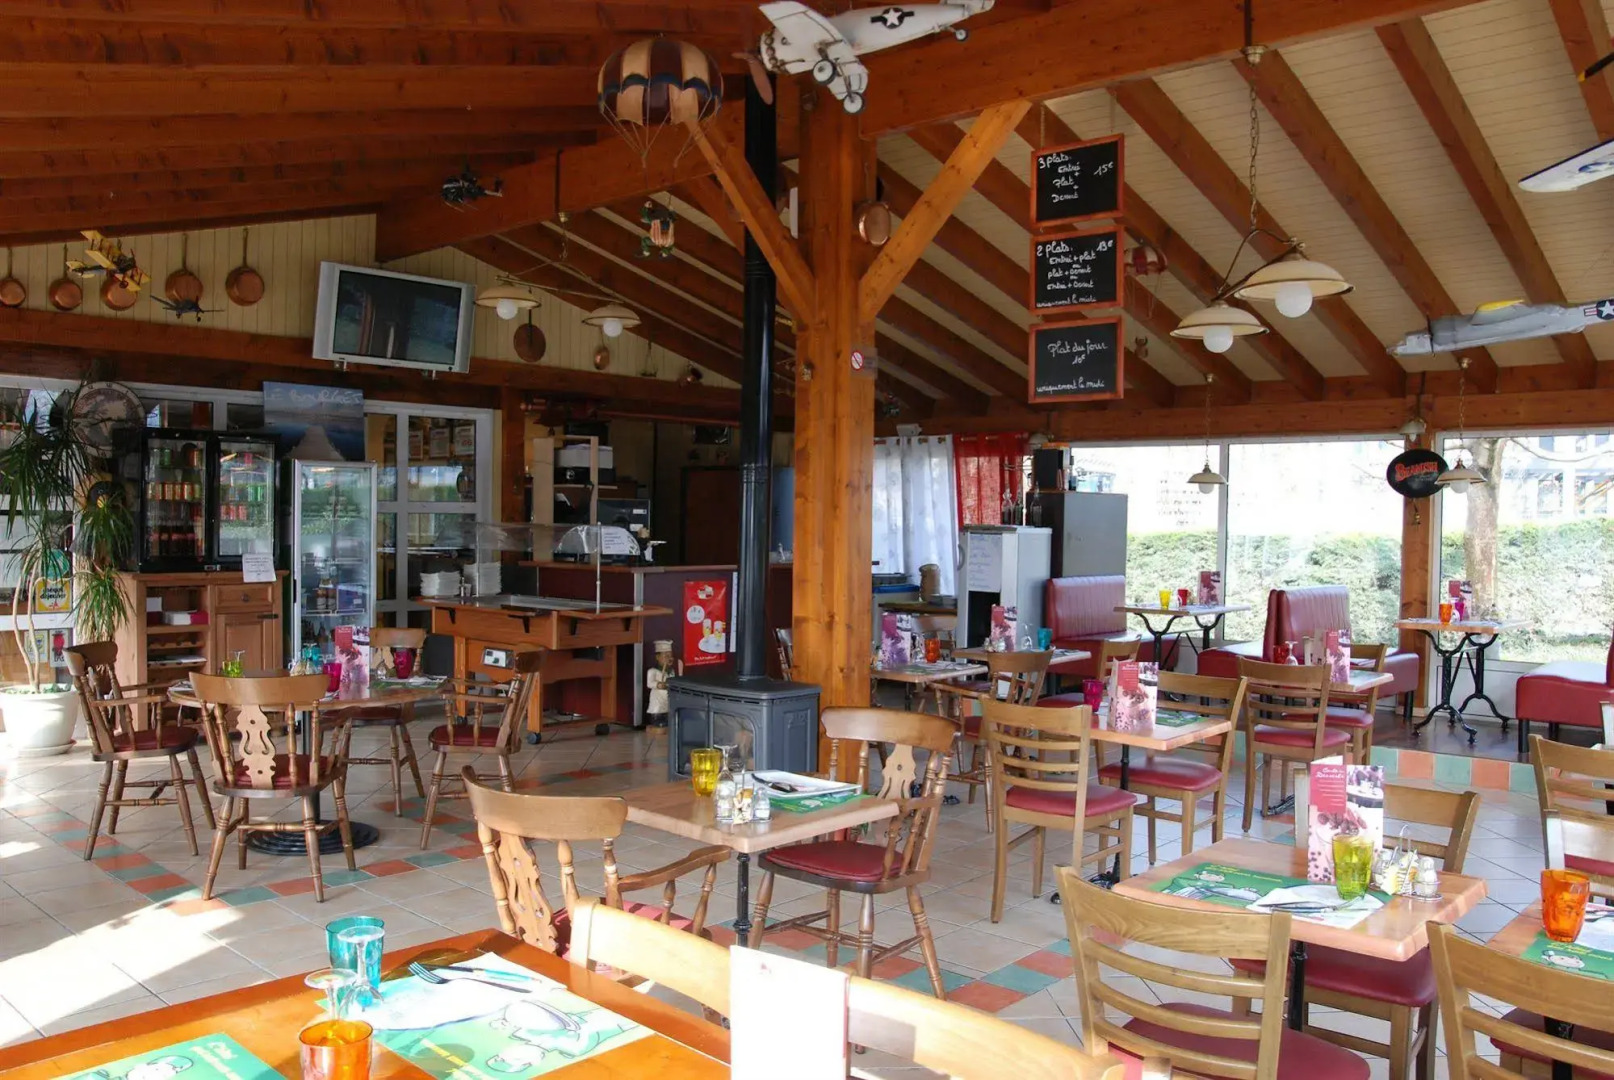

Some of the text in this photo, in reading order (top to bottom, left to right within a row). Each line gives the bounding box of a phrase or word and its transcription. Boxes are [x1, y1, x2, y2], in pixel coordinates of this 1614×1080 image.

[1038, 157, 1046, 169] 3
[1036, 245, 1043, 257] 2
[1047, 339, 1108, 358] Plat du jour
[1078, 376, 1085, 389] le
[1086, 378, 1105, 388] midi
